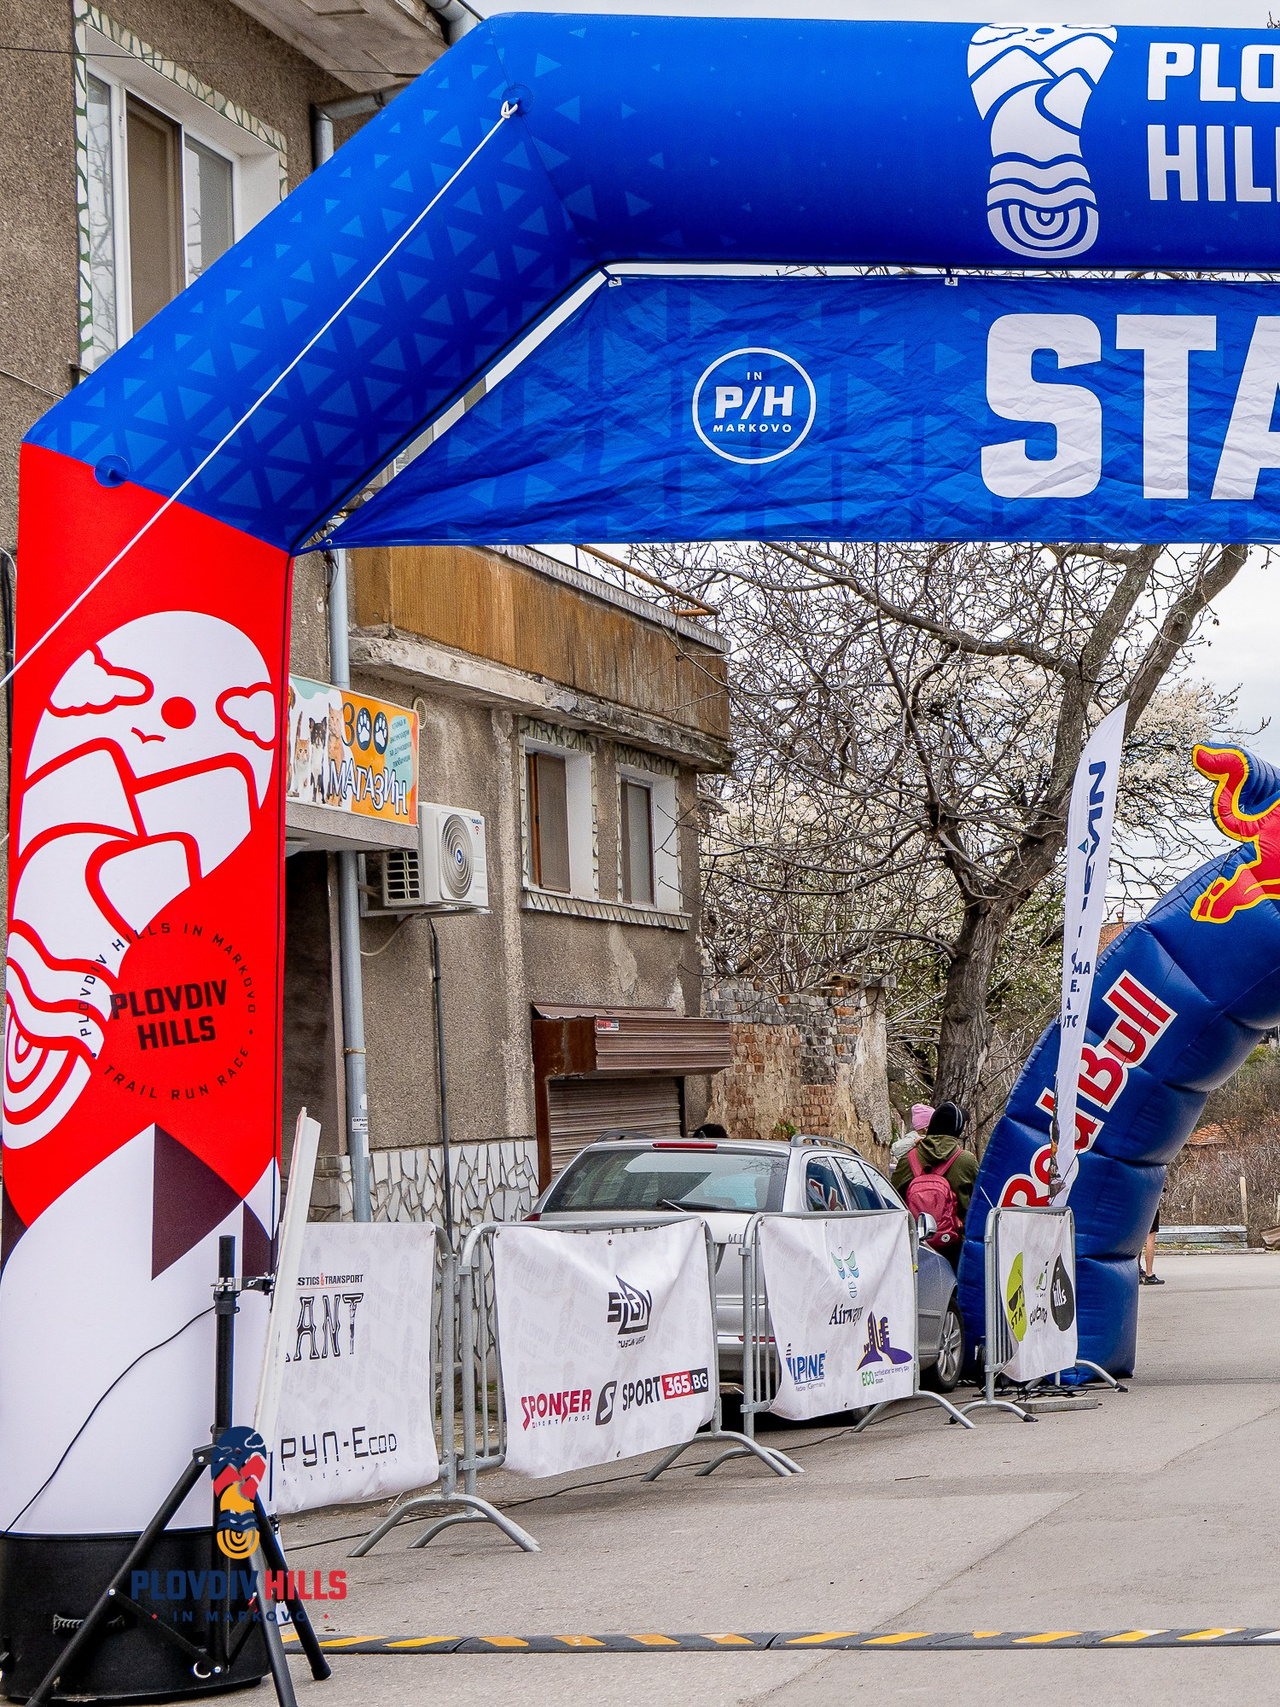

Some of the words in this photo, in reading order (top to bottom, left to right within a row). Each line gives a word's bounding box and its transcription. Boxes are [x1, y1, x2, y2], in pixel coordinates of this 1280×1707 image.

[746, 371, 762, 381] IN
[715, 385, 794, 420] P/H
[712, 423, 792, 433] MARKOVO
[329, 758, 408, 815] МАГАЗИН
[78, 954, 107, 1037] PLOVDIV
[112, 923, 170, 951] HILLS
[184, 923, 203, 936] IN
[212, 933, 256, 1013] MARKOVO
[109, 979, 227, 1020] PLOVDIV
[137, 1015, 216, 1050] HILLS
[1075, 976, 1171, 1107] Bull
[104, 1065, 157, 1099] TRAIL
[171, 1084, 209, 1100] RUN
[217, 1047, 249, 1087] RACE
[286, 1292, 364, 1363] ANT
[861, 1371, 875, 1387] ECO
[521, 1389, 592, 1431] SPONSER
